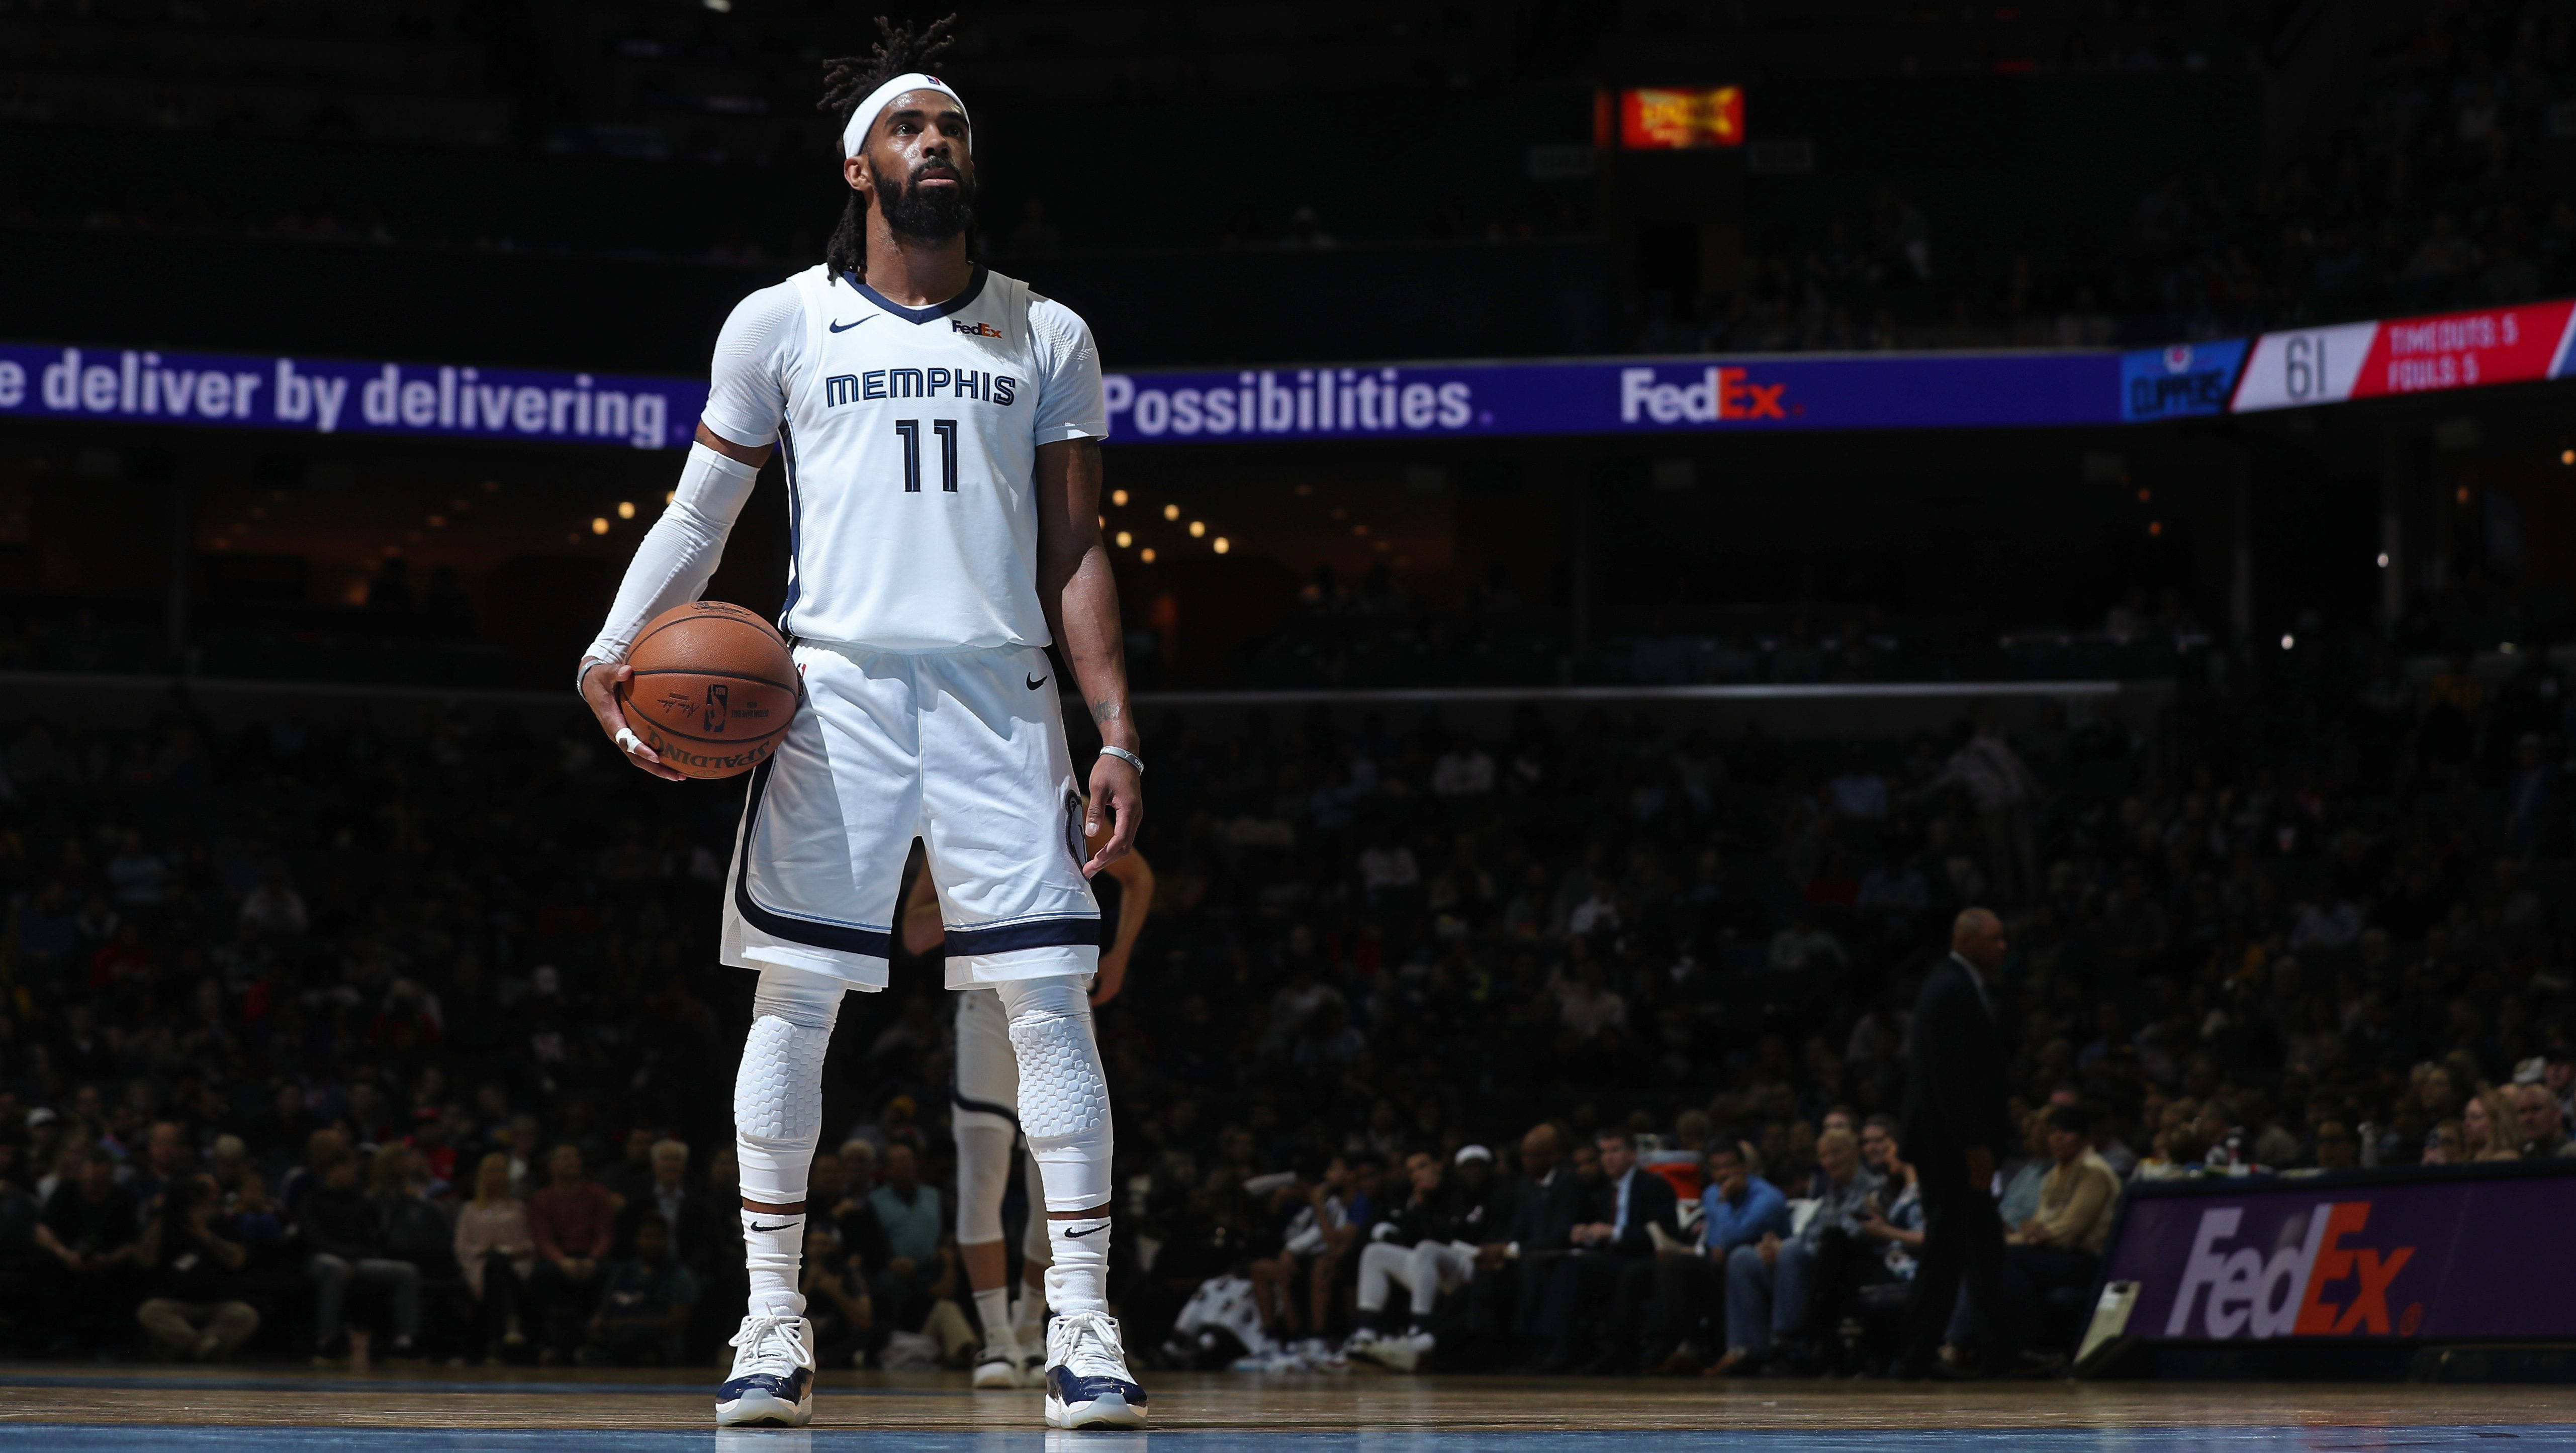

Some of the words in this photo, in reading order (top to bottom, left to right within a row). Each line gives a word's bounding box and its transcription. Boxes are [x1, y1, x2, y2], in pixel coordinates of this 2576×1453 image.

[952, 319, 1003, 339] FedEx
[43, 348, 260, 418] deliver
[276, 357, 346, 432] by
[362, 363, 666, 448] delivering
[826, 367, 1016, 408] MEMPHIS
[1621, 366, 1786, 423] FedEx
[2285, 337, 2327, 398] 61
[1102, 368, 1470, 435] Possibilities
[895, 419, 957, 492] 11
[648, 730, 769, 768] SPALDING
[2163, 1202, 2417, 1339] FedEx
